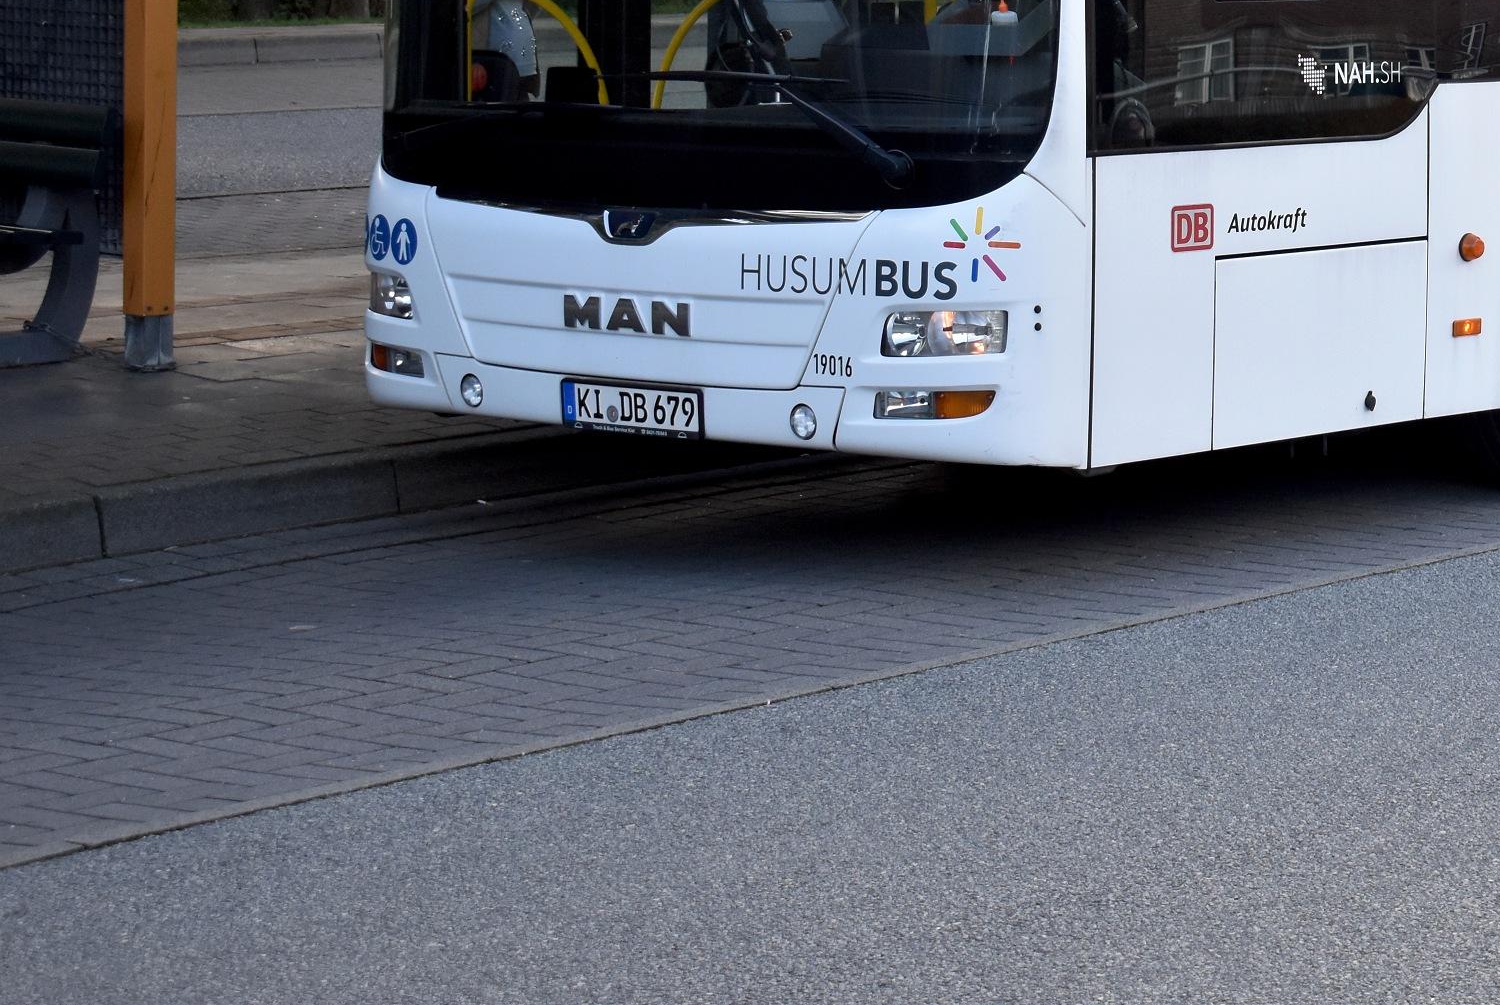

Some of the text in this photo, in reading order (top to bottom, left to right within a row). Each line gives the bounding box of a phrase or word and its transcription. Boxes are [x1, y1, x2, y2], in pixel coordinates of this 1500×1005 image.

[1334, 61, 1401, 85] NAH.SH
[1175, 207, 1308, 246] DB Autokraft
[741, 252, 959, 301] HUSUMBUS
[563, 294, 692, 338] MAN
[813, 353, 853, 377] 19016
[577, 387, 695, 427] KI DB 679
